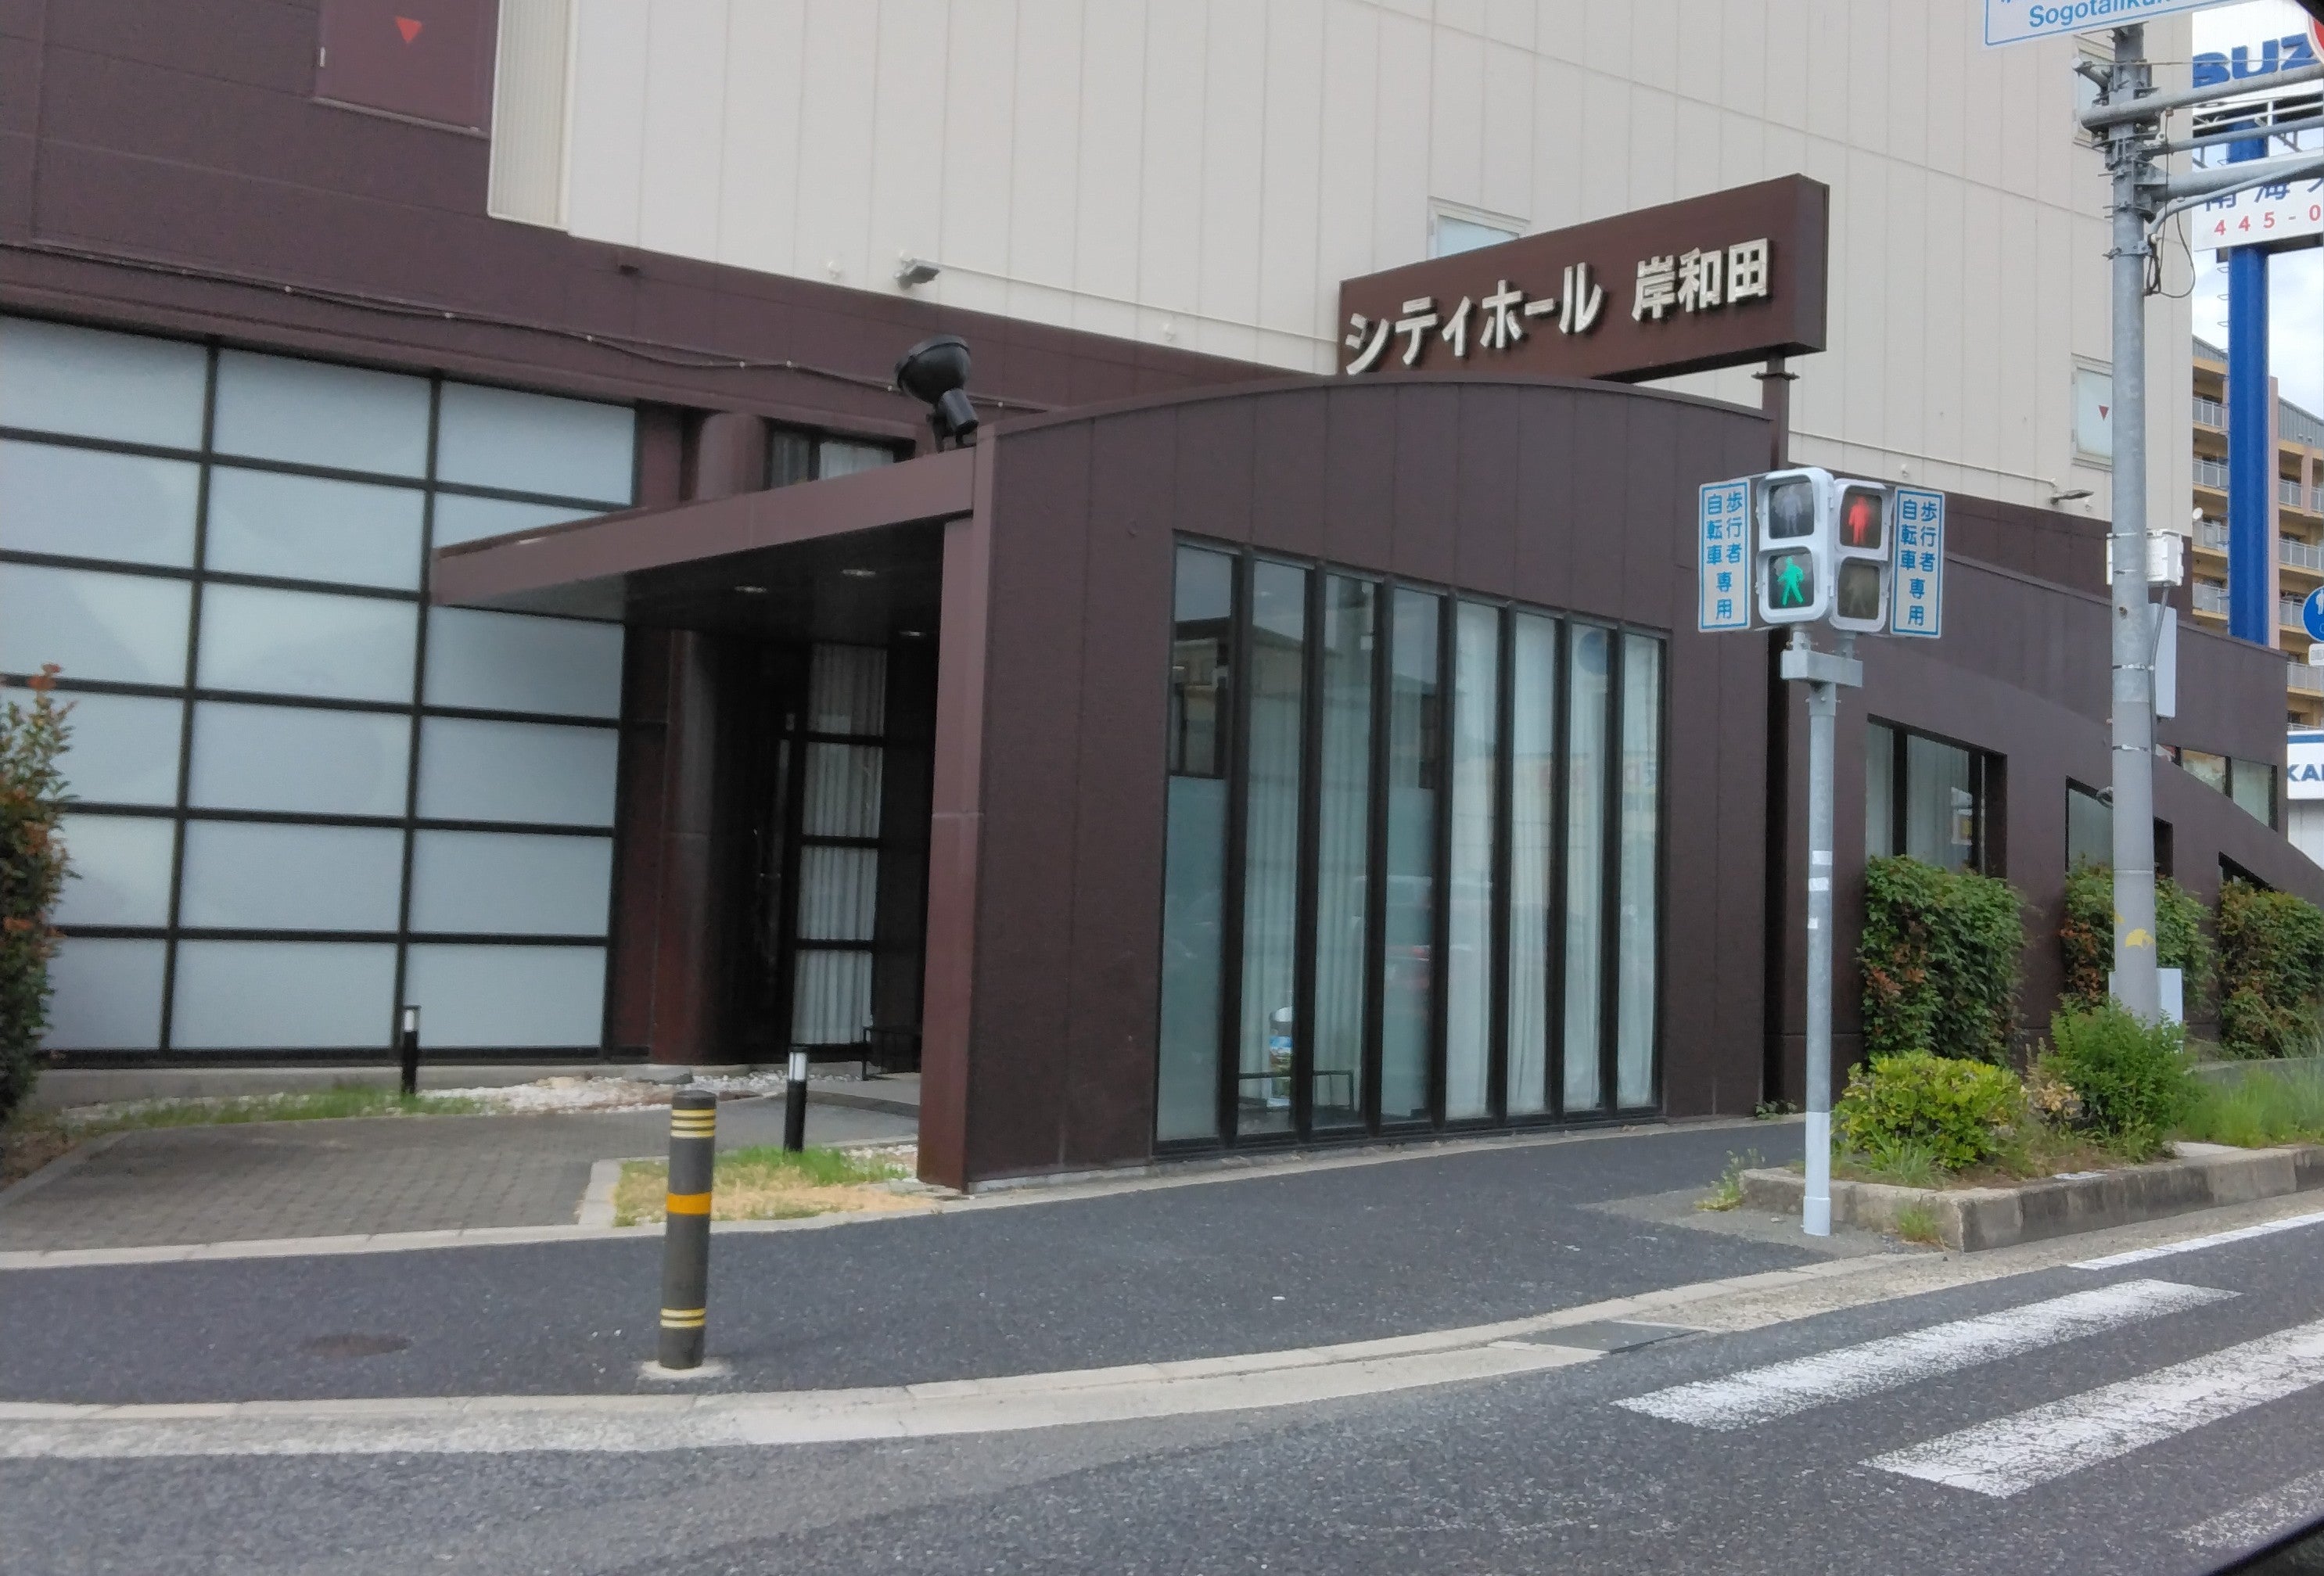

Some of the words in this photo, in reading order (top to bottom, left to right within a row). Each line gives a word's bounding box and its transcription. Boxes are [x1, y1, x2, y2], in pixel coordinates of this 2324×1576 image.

[2029, 0, 2171, 27] Sogotai
[2214, 204, 2322, 236] 445-0
[1632, 237, 1770, 321] 岸和田
[1706, 494, 1723, 565] 自転車
[1726, 491, 1743, 564] 歩行者
[1900, 499, 1917, 570] 自転車
[1920, 501, 1937, 573] 歩行者
[1715, 571, 1733, 620] 専用
[1909, 578, 1926, 626] 専用
[2287, 763, 2324, 781] KA
